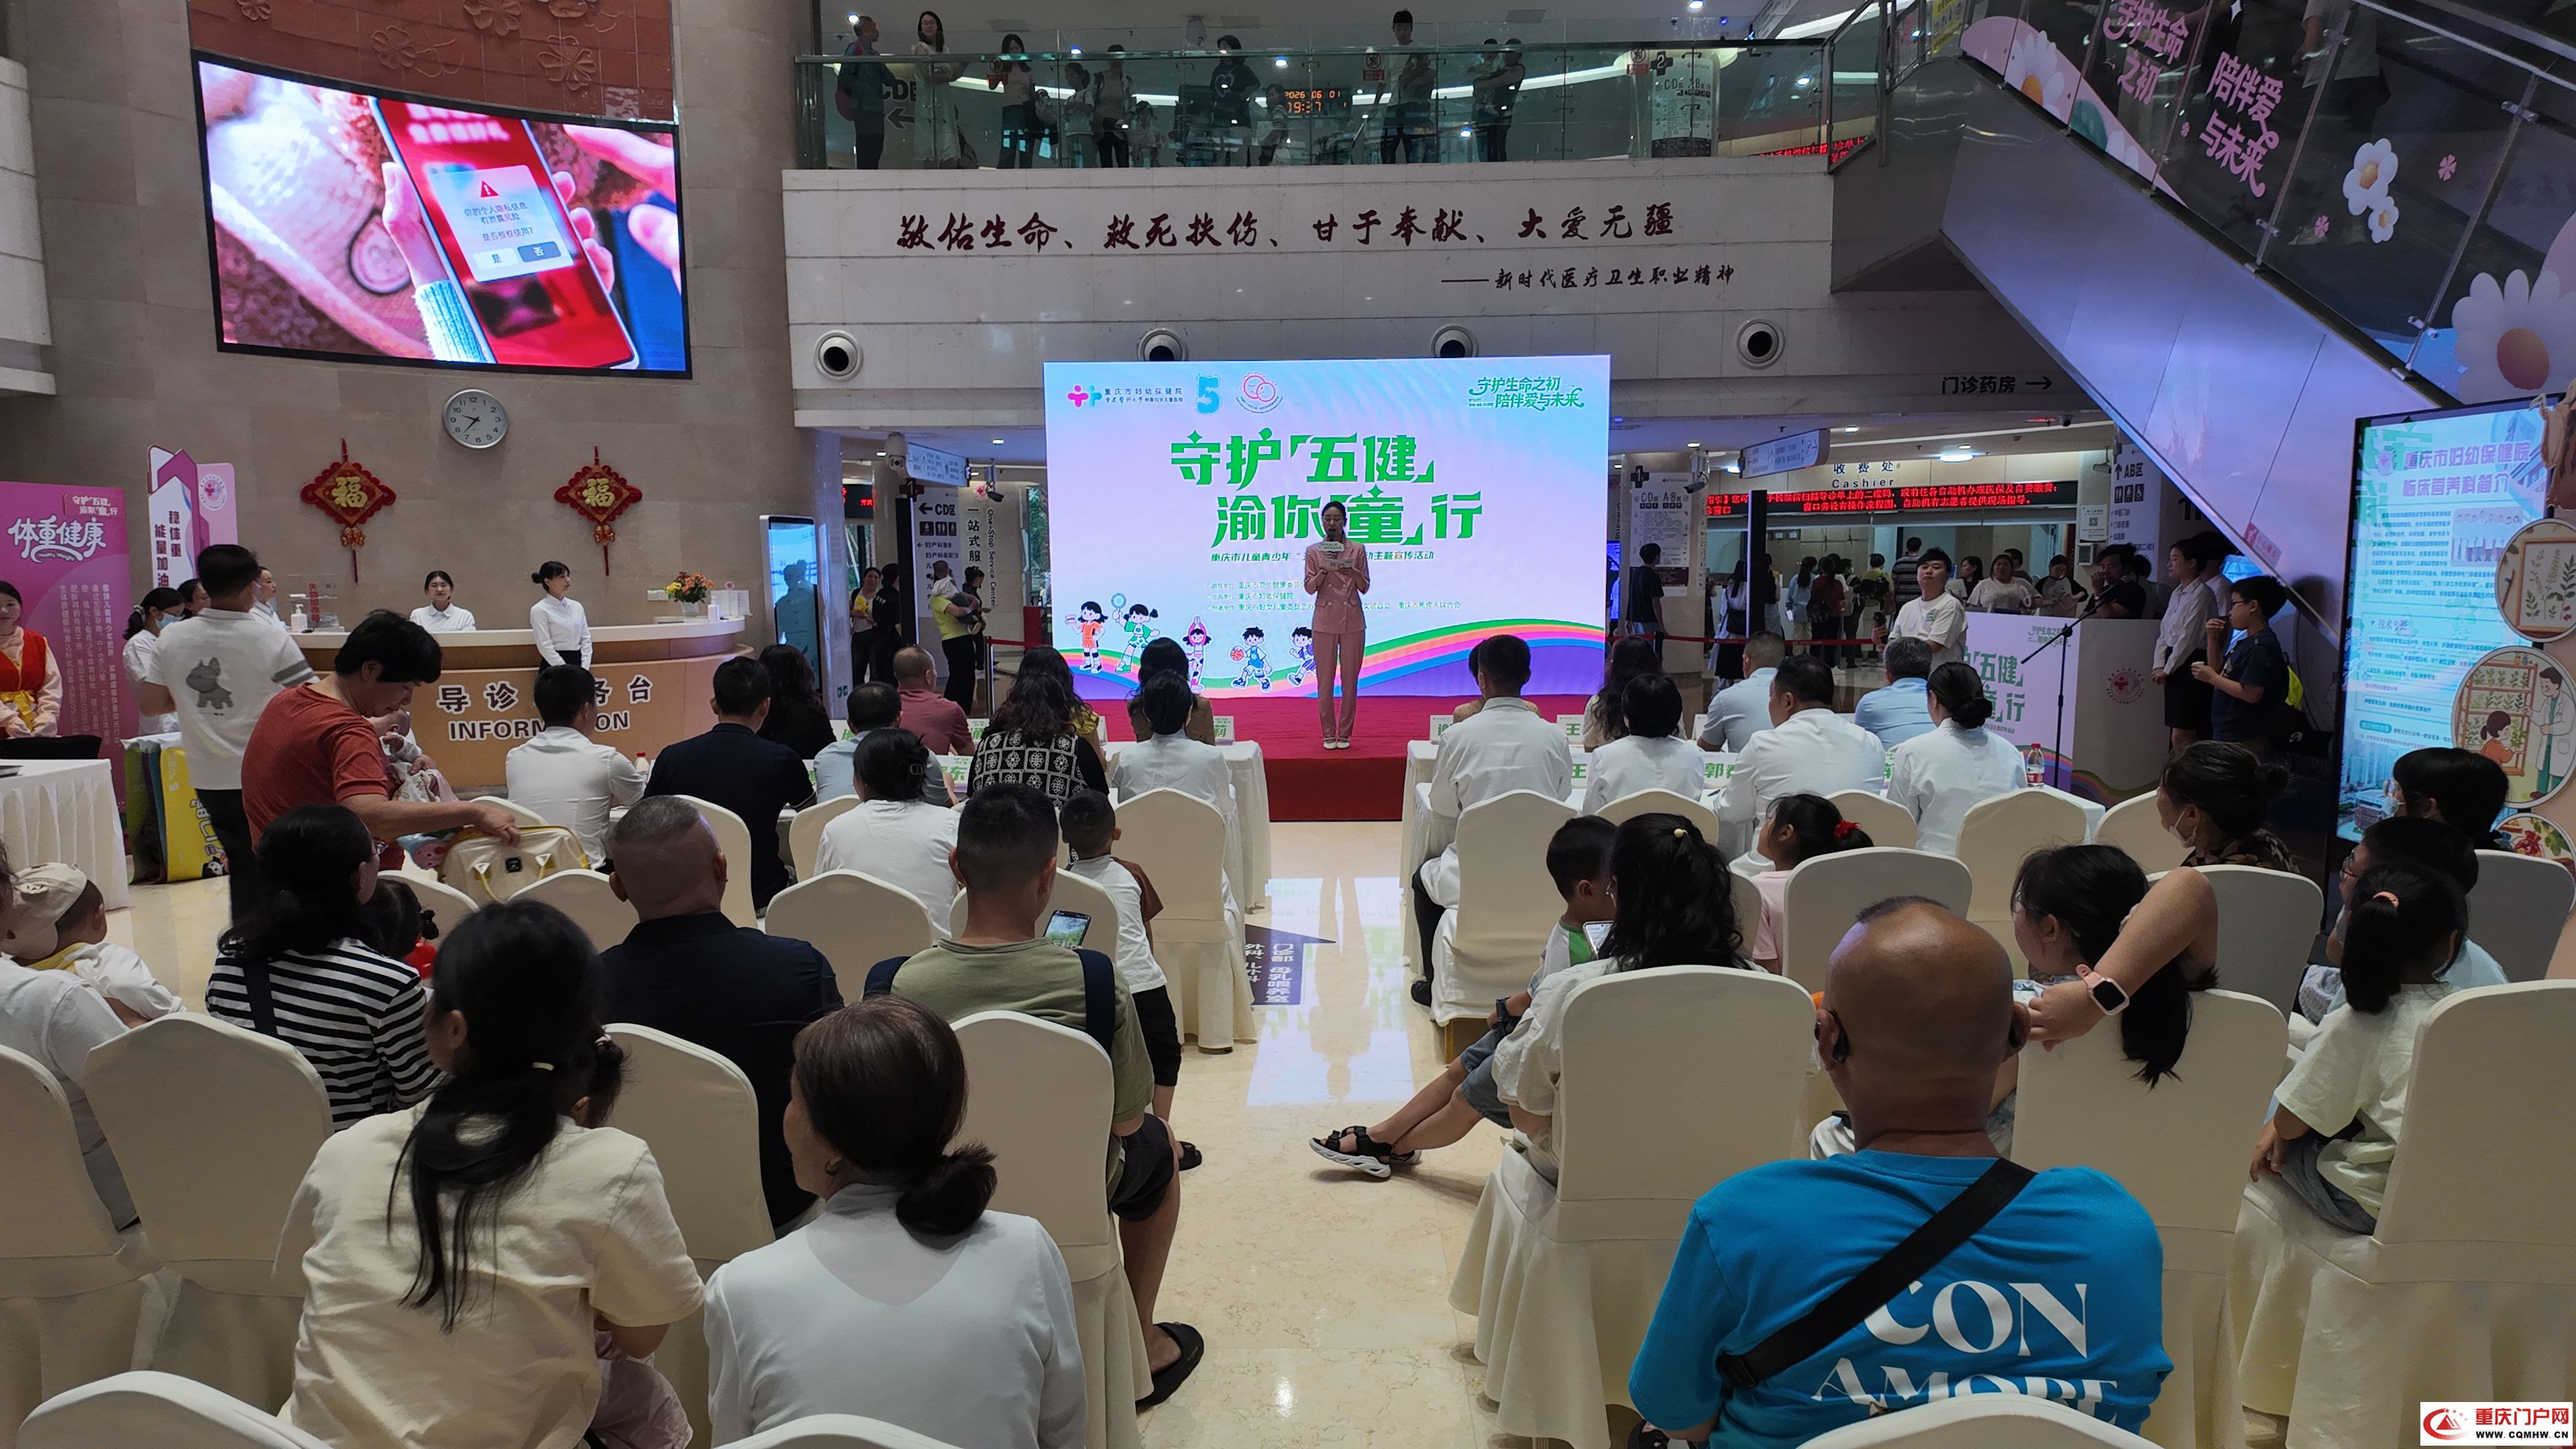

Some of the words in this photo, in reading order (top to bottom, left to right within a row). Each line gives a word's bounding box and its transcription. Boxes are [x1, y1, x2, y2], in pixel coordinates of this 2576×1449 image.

[1656, 54, 1665, 68] 2
[2117, 50, 2162, 105] 之初
[2205, 51, 2284, 127] 陪伴爱
[2200, 109, 2279, 198] 与未来
[492, 254, 503, 264] 是
[534, 247, 545, 256] 否
[1104, 388, 1183, 396] 重庆市妇幼保健院
[1942, 376, 2016, 394] 门诊药房
[1833, 461, 1894, 474] 收费处
[2404, 442, 2530, 470] 重庆市妇幼保健院
[2124, 462, 2143, 478] AB区
[332, 476, 368, 508] 福
[582, 478, 615, 507] 福
[1832, 478, 1894, 488] Cashier
[2402, 473, 2510, 497] 临床营养科简介
[935, 504, 956, 516] CD区
[7, 515, 107, 559] 体重健康
[168, 511, 182, 557] 稳体重
[439, 676, 651, 712] 导诊务台
[1566, 723, 1580, 736] 王
[1864, 1280, 2088, 1358] CON
